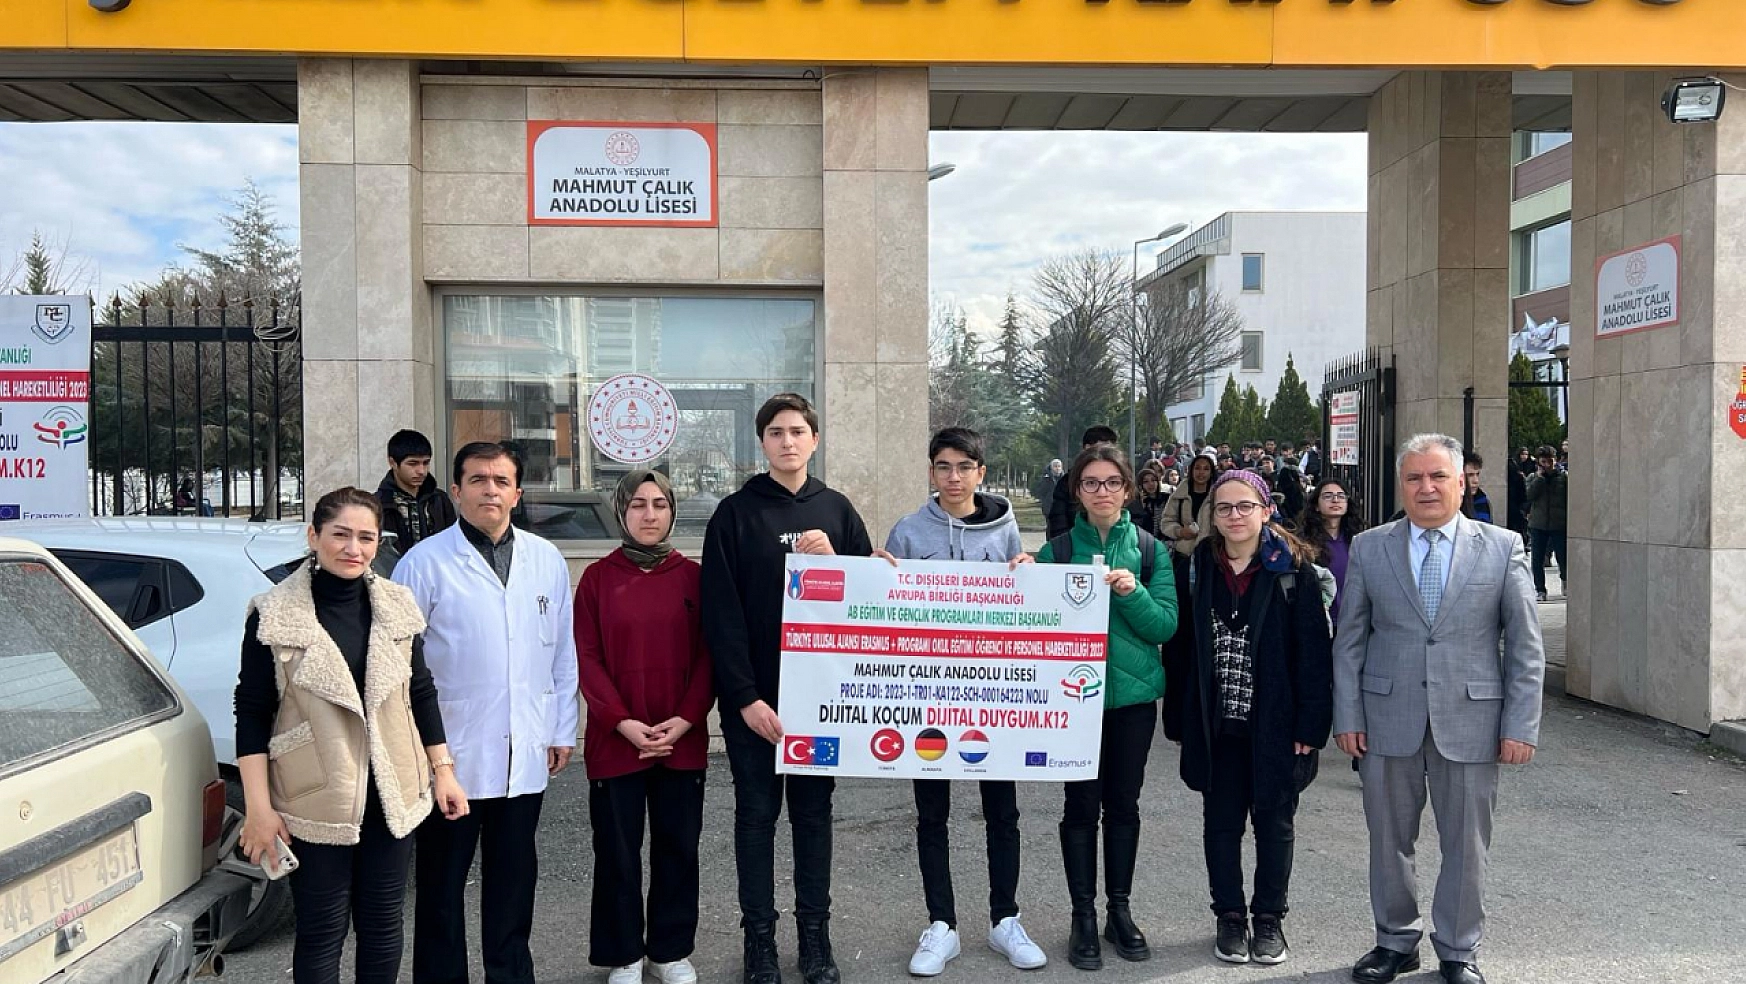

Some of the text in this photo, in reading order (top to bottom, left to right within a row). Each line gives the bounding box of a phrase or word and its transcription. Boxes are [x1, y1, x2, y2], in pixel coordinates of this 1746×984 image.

[574, 167, 617, 176] MALATYA
[624, 168, 670, 178] YEŞİLYURT
[553, 179, 694, 198] MAHMUT ÇALIK
[549, 196, 697, 214] ANADOLU LİSESİ
[1604, 290, 1670, 316] MAHMUT ÇALIK
[1601, 303, 1671, 330] ANADOLU LİSESİ
[0, 344, 32, 365] ANLIĞI
[13, 376, 67, 398] HAREKETLİLİĞİ
[69, 381, 88, 398] 2023
[898, 573, 914, 585] T.C.
[962, 574, 1015, 589] BAKANLIĞI
[888, 588, 1024, 607] AVRUPA BİRLİĞİ BAŞKANLIĞI
[847, 601, 1062, 629] AB EĞİTİM VE GENÇLİK PROGRAMLARI MERKEZİ BAŞKANLIĞI
[786, 628, 811, 649] TÜRKİYE
[812, 633, 836, 649] ULUSAL
[861, 635, 890, 651] ERASMUS
[897, 636, 930, 653] PROGRAMI
[932, 638, 950, 654] OKUL
[1004, 640, 1012, 656] VE
[1013, 640, 1043, 656] PERSONEL
[854, 663, 1036, 682] MAHMUT ÇALIK ANADOLU LİSESİ
[840, 683, 864, 698] PROJE
[866, 684, 883, 699] ADI:
[1025, 689, 1049, 704] NOLU
[819, 699, 1069, 729] DİJİTAL KOÇUM DİJİTAL DUYGUM.K12
[1049, 758, 1092, 768] Erasmus+
